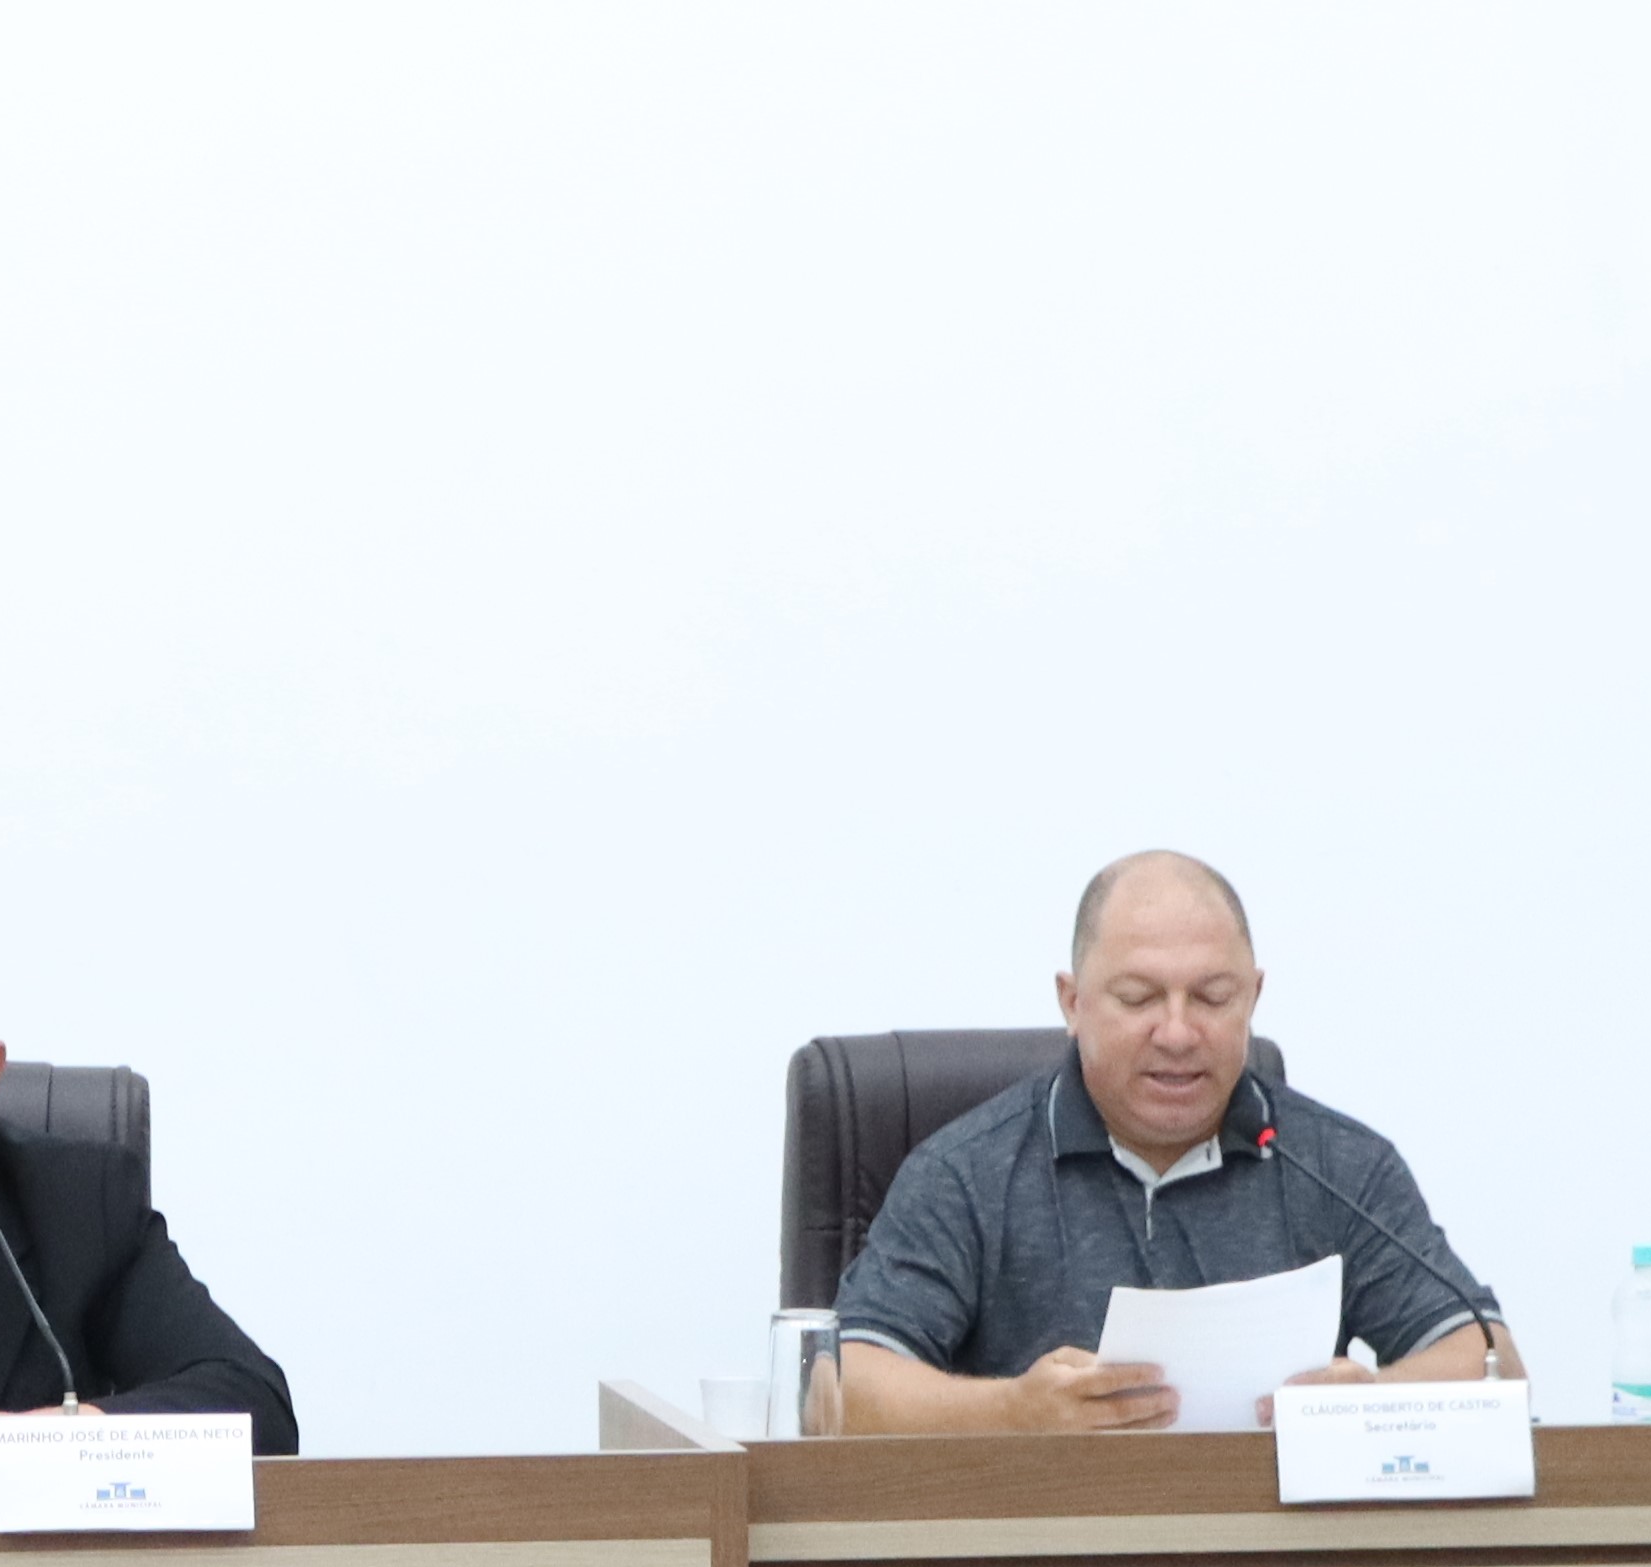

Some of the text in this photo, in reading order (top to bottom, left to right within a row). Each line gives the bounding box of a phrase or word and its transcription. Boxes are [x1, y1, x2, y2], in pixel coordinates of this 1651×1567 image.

[1301, 1398, 1501, 1416] CLÁUDIO ROBERTO DE CASTRO
[1364, 1420, 1437, 1433] Secretário
[69, 1427, 105, 1443] JOSÉ
[109, 1430, 129, 1441] DE
[134, 1429, 198, 1441] ALMEIDA
[203, 1428, 244, 1440] NETO
[79, 1448, 155, 1461] Presidente
